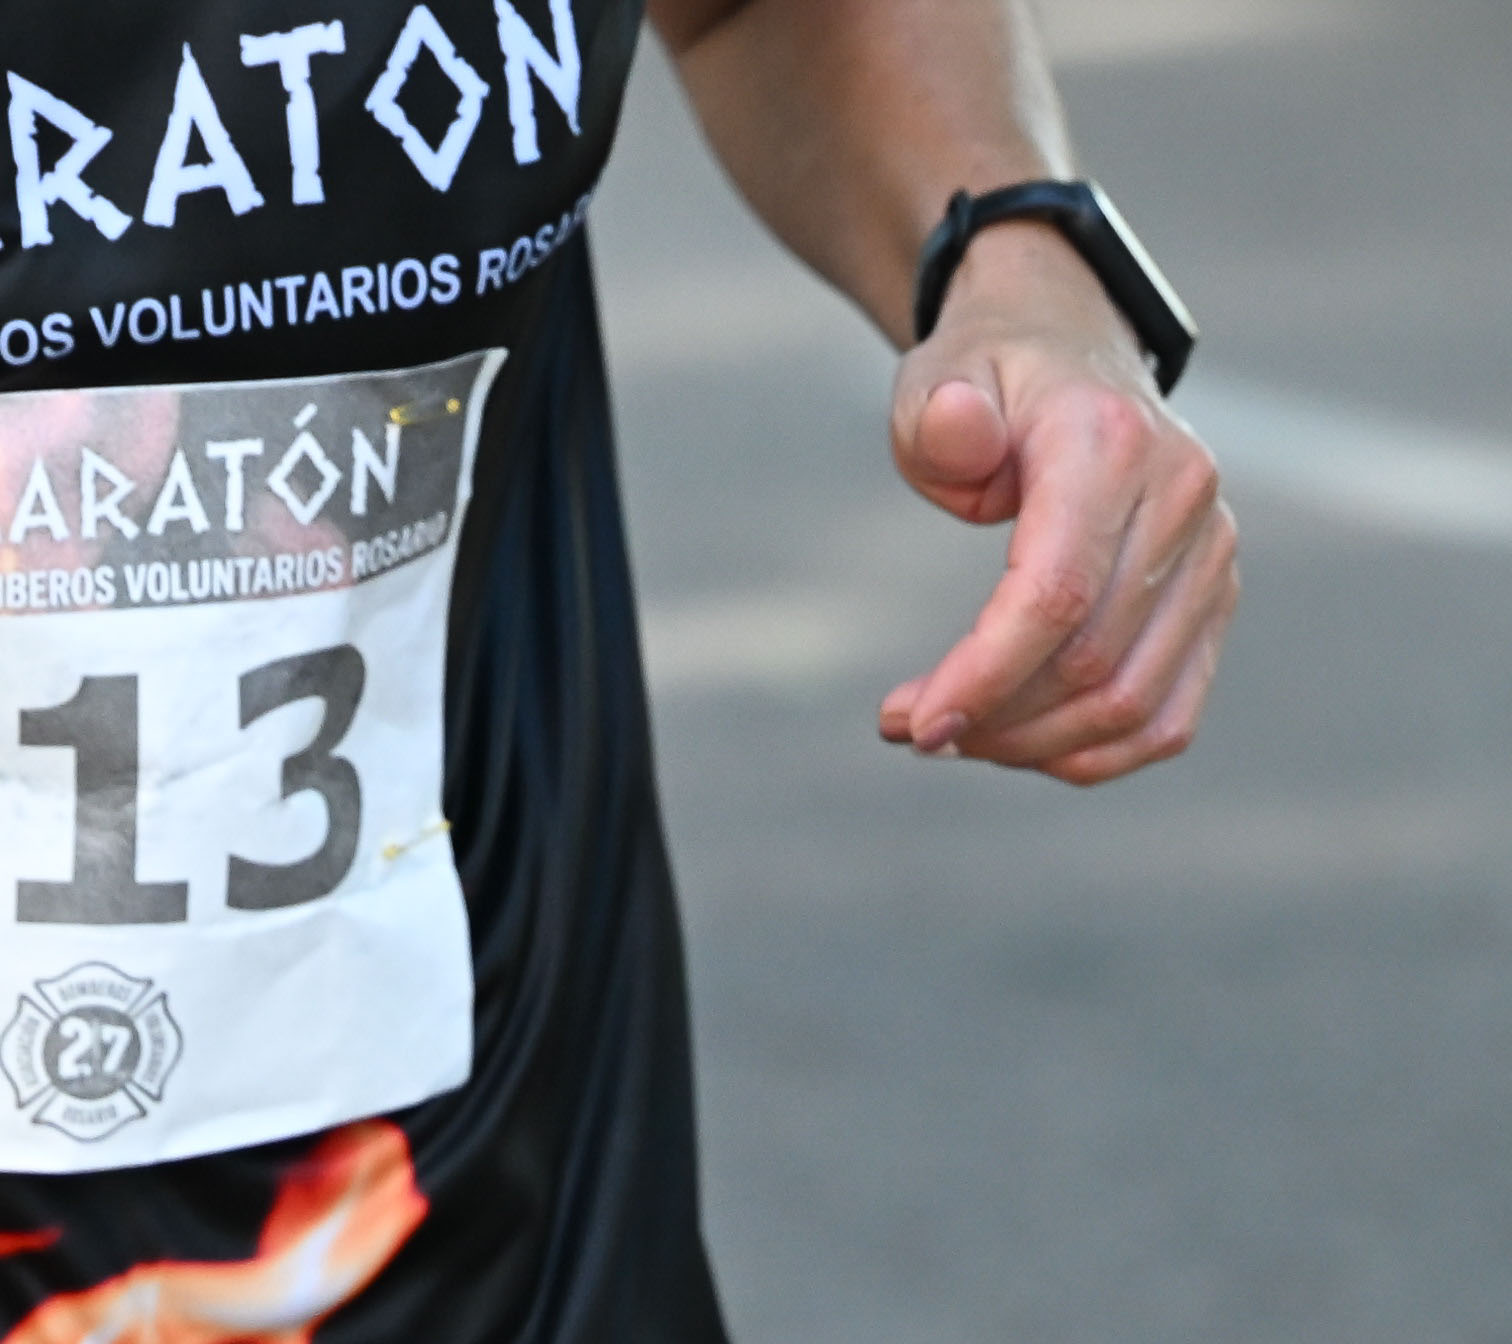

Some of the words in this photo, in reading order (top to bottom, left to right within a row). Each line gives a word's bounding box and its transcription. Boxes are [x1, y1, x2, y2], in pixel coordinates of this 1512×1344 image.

[89, 253, 462, 348] VOLUNTARIOS
[123, 546, 343, 605] VOLUNTARIOS
[57, 1015, 131, 1080] 27
